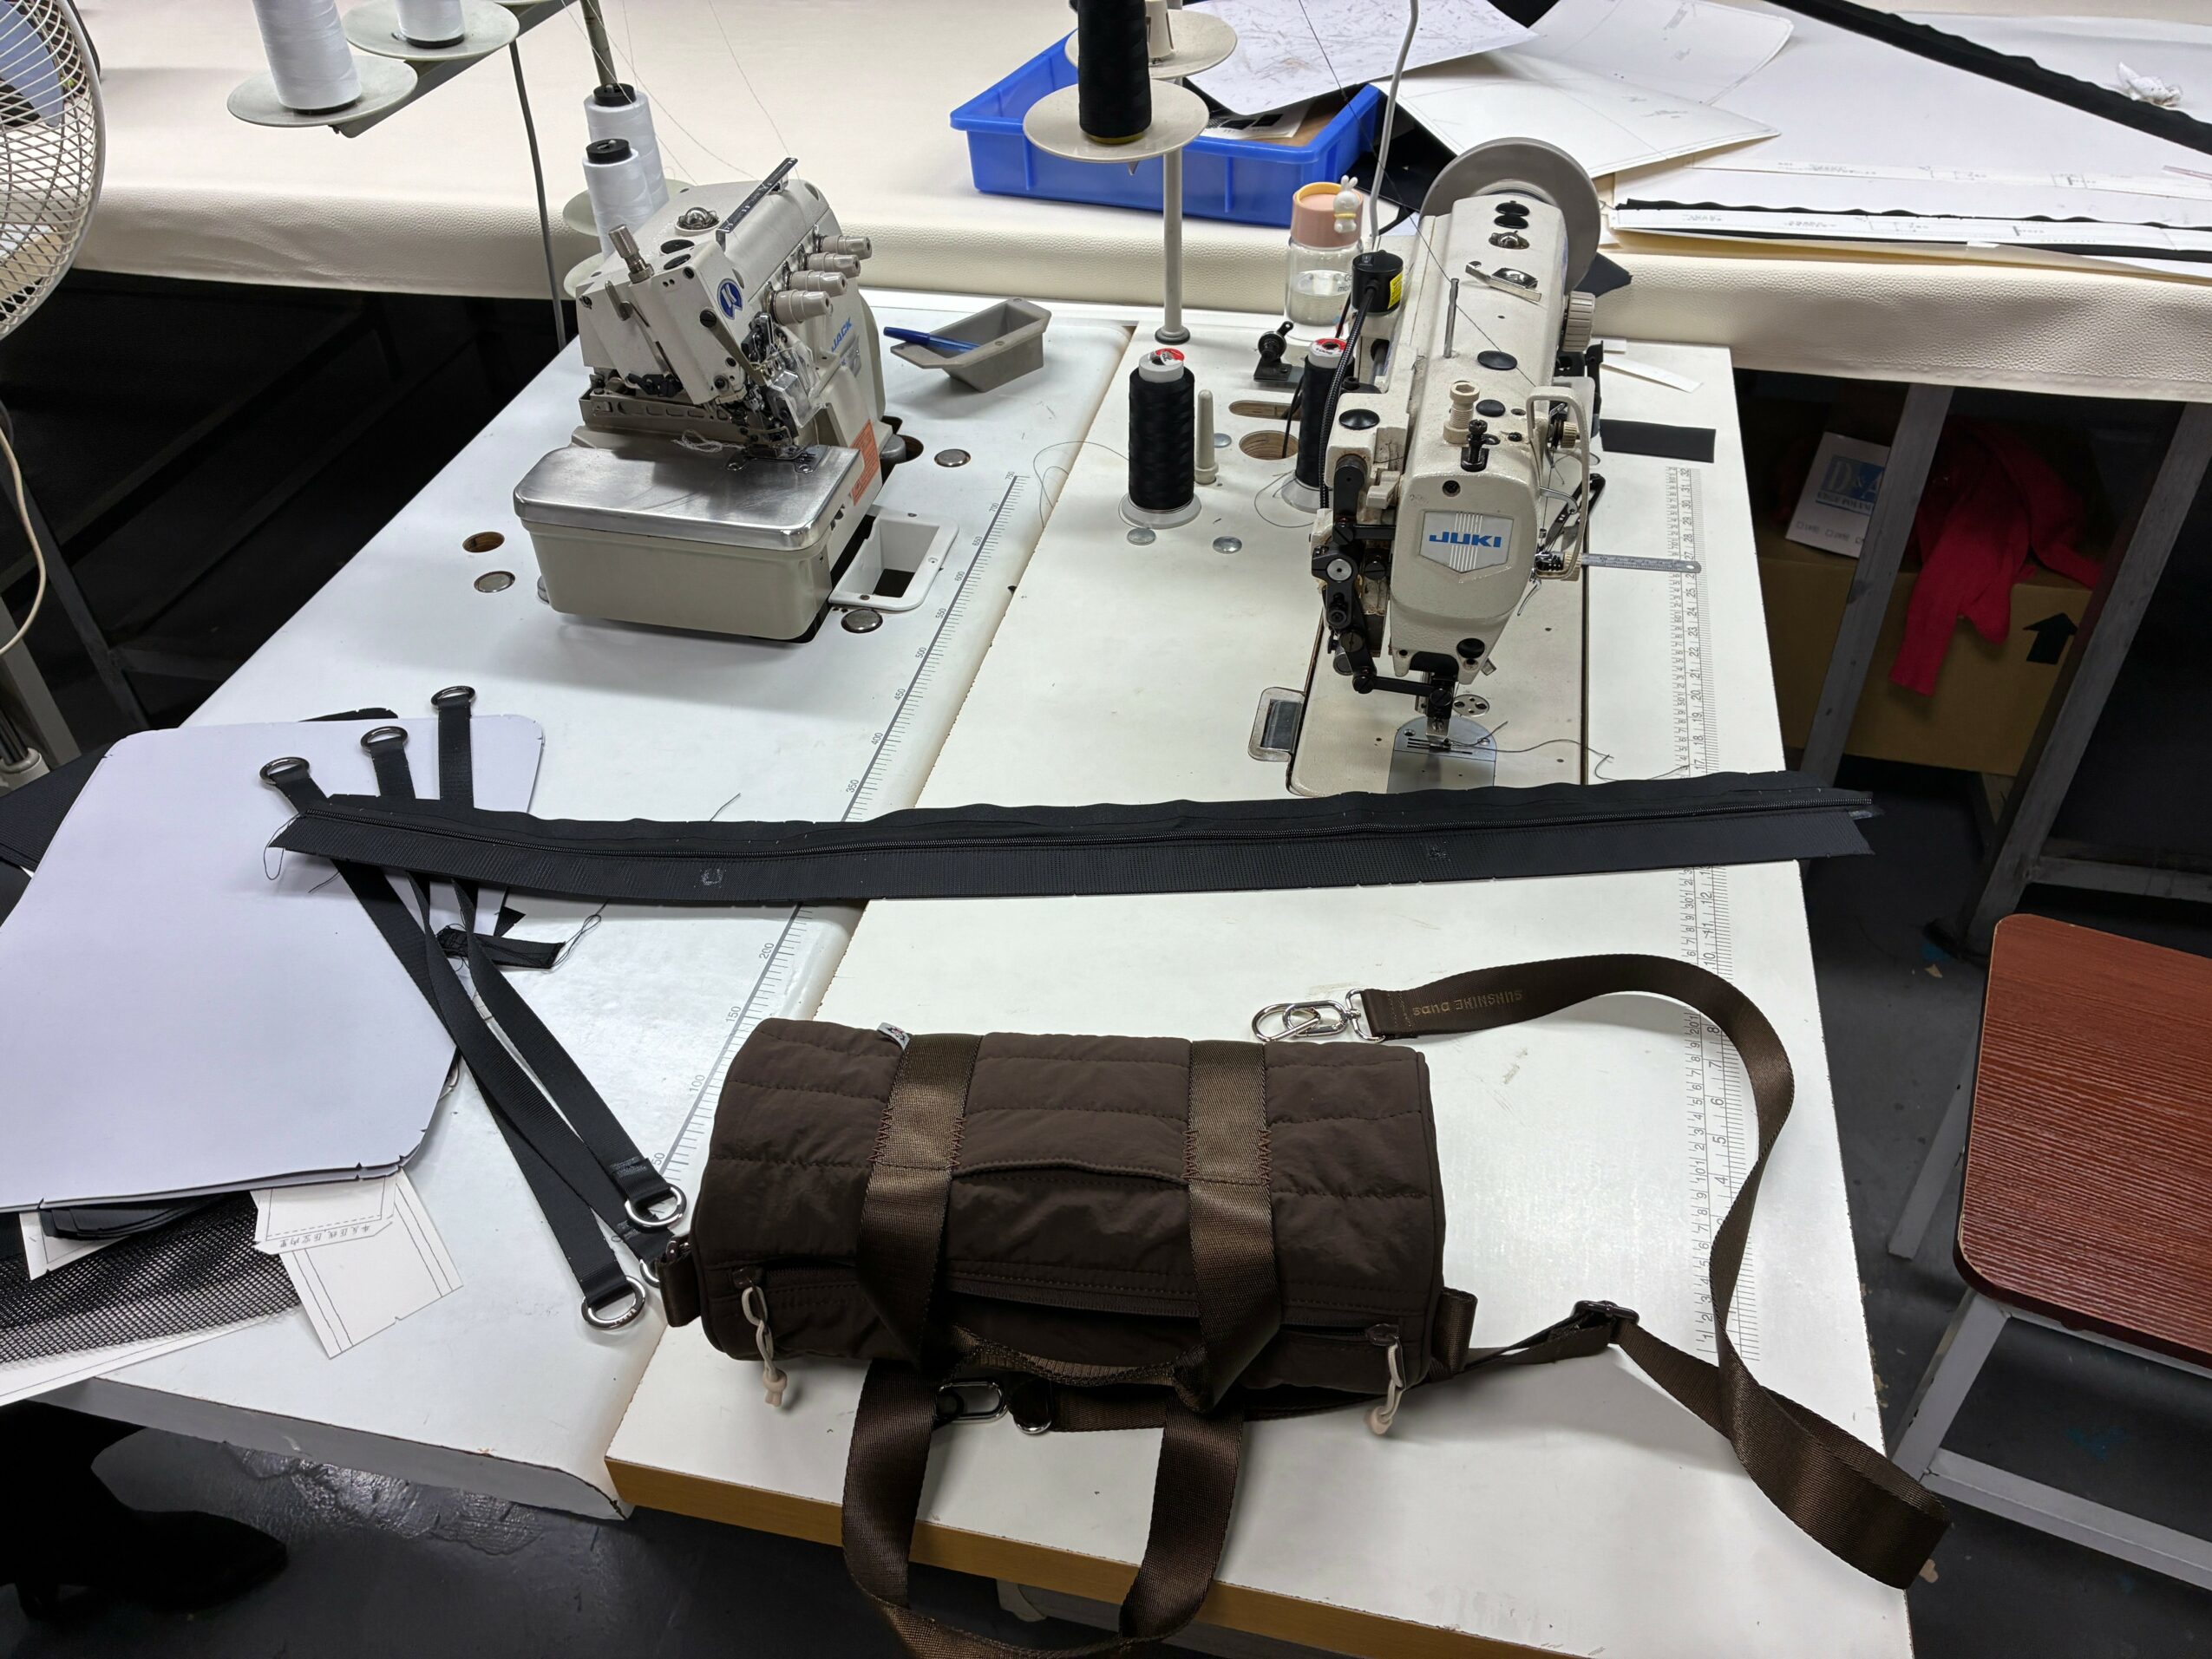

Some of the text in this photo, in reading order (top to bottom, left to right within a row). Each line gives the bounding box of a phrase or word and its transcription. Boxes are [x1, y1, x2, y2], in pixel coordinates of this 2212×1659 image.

[831, 317, 853, 353] JACK
[1682, 516, 1692, 526] 29
[1429, 532, 1502, 547] JUKI
[1683, 533, 1693, 543] 28
[1684, 551, 1694, 560] 27
[1685, 588, 1696, 598] 25
[1686, 607, 1698, 617] 24
[1687, 626, 1698, 637] 23
[1689, 646, 1699, 657] 22
[1690, 669, 1700, 679] 21
[1690, 689, 1701, 701] 20
[1692, 712, 1703, 722] 19
[1692, 735, 1704, 746] 18
[1693, 759, 1705, 770] 17
[651, 1153, 665, 1166] 50
[689, 1074, 705, 1092] 100
[725, 1006, 742, 1022] 150
[758, 943, 775, 960] 200
[846, 779, 860, 793] 350
[871, 732, 883, 745] 400
[893, 688, 906, 701] 450
[915, 647, 927, 658] 500
[935, 608, 947, 619] 550
[954, 571, 965, 582] 600
[972, 536, 983, 547] 650
[989, 502, 999, 513] 700
[1005, 471, 1015, 480] 750
[1699, 892, 1712, 905] 12
[1702, 921, 1714, 935] 11
[1703, 952, 1716, 966] 10
[1712, 1136, 1726, 1145] 5
[1714, 1176, 1729, 1185] 4
